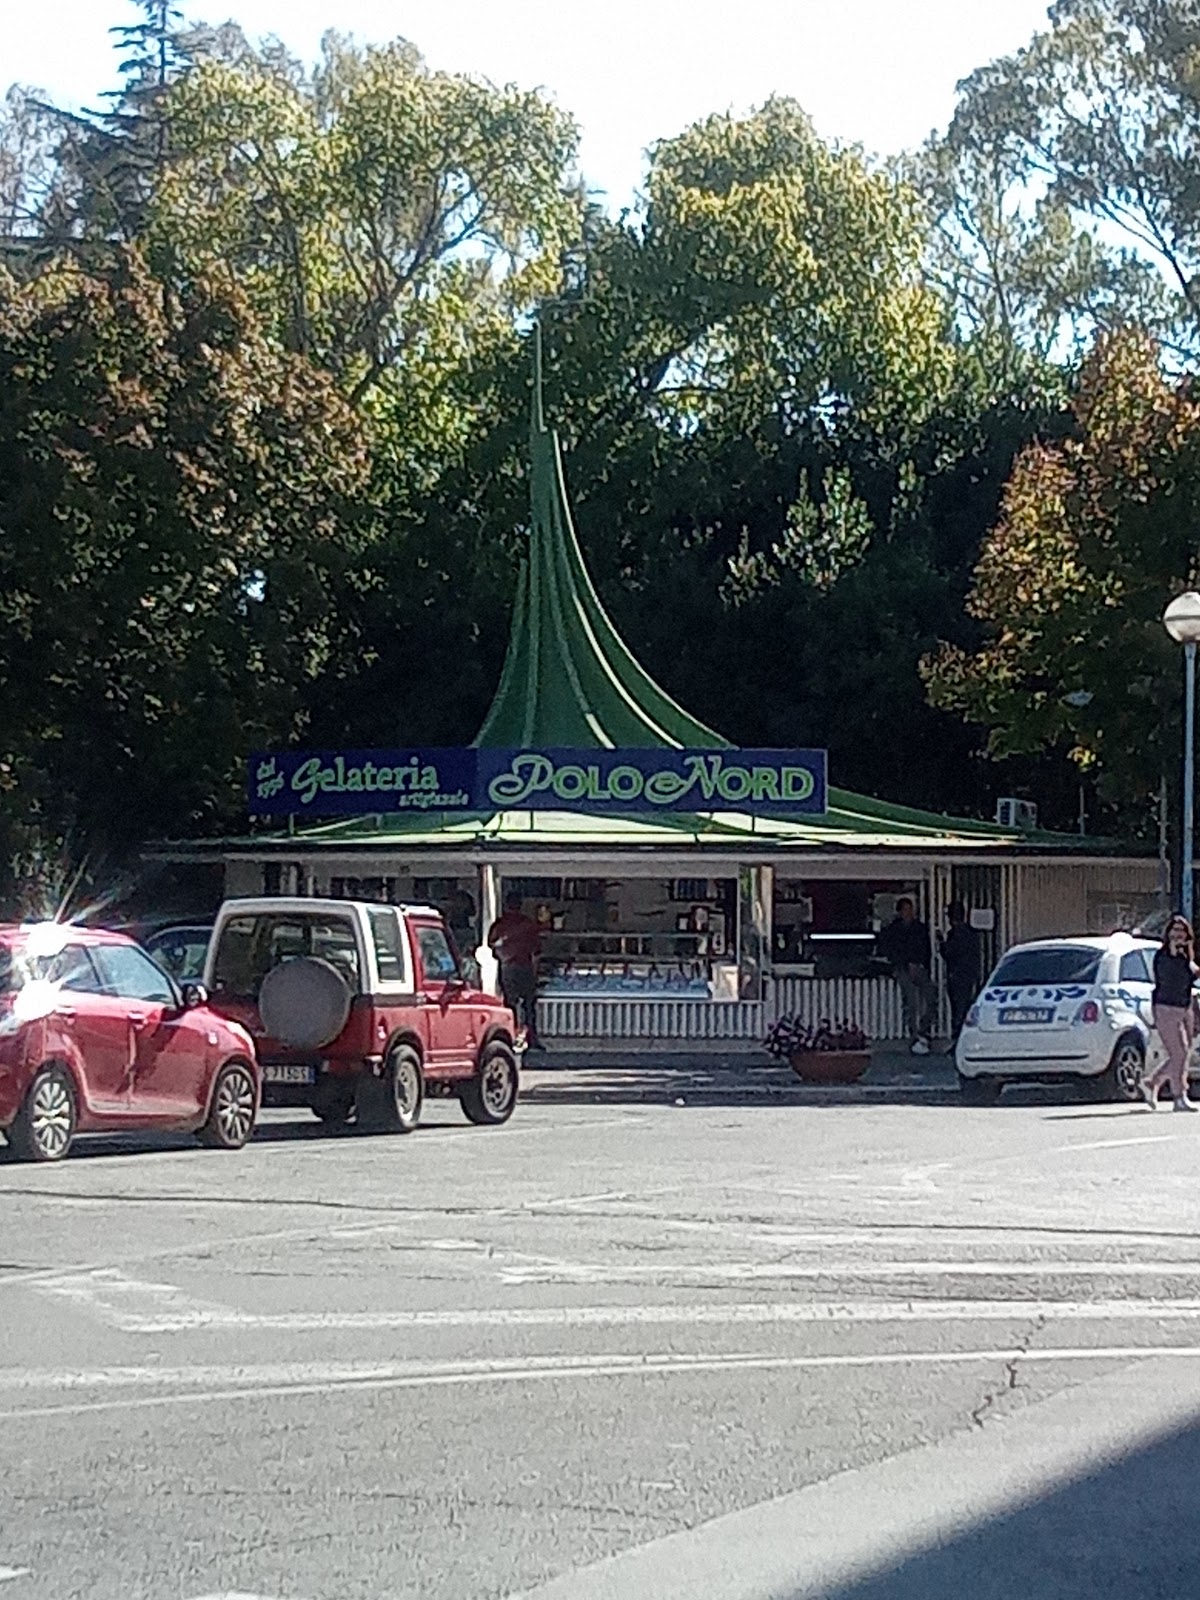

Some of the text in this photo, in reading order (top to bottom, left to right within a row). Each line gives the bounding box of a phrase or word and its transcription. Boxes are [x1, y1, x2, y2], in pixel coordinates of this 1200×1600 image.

[291, 756, 440, 803] Gelateria
[488, 754, 815, 804] POLO NORD
